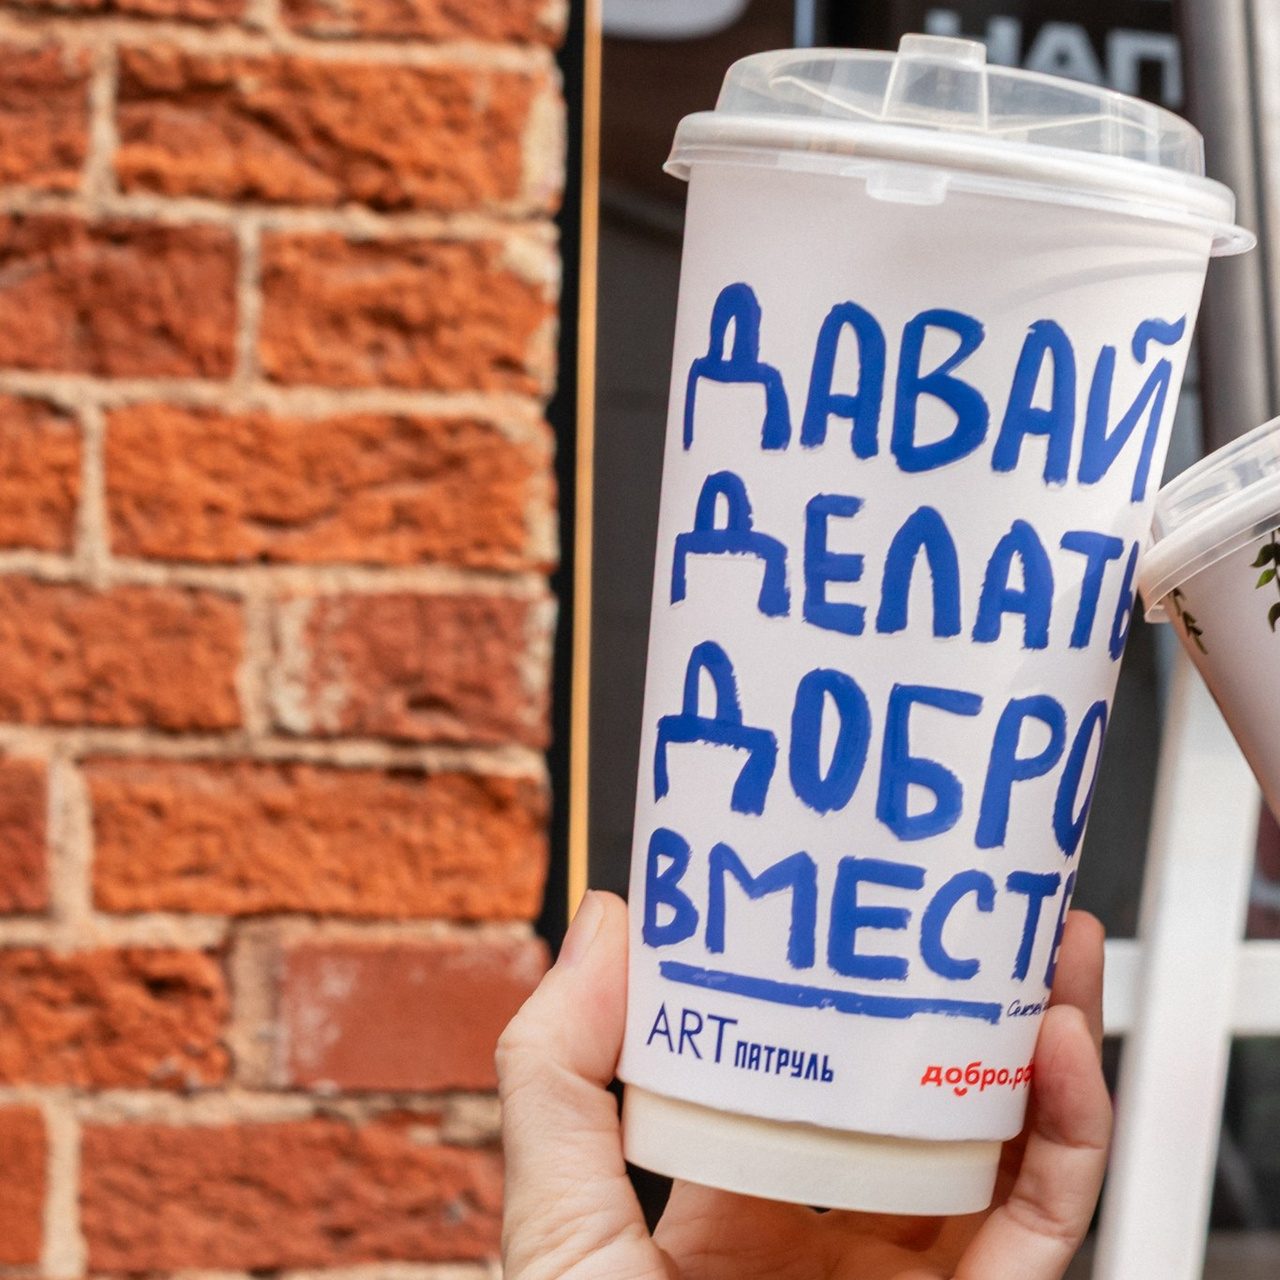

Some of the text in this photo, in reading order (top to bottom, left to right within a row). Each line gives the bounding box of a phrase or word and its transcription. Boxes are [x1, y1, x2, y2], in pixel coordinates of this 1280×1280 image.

[682, 281, 1188, 504] ДАВАЙ
[670, 469, 1140, 661] ДЕЛАТЬ
[652, 639, 1108, 858] ДОБРО
[646, 1001, 835, 1084] ART ПАТРУЛЬ
